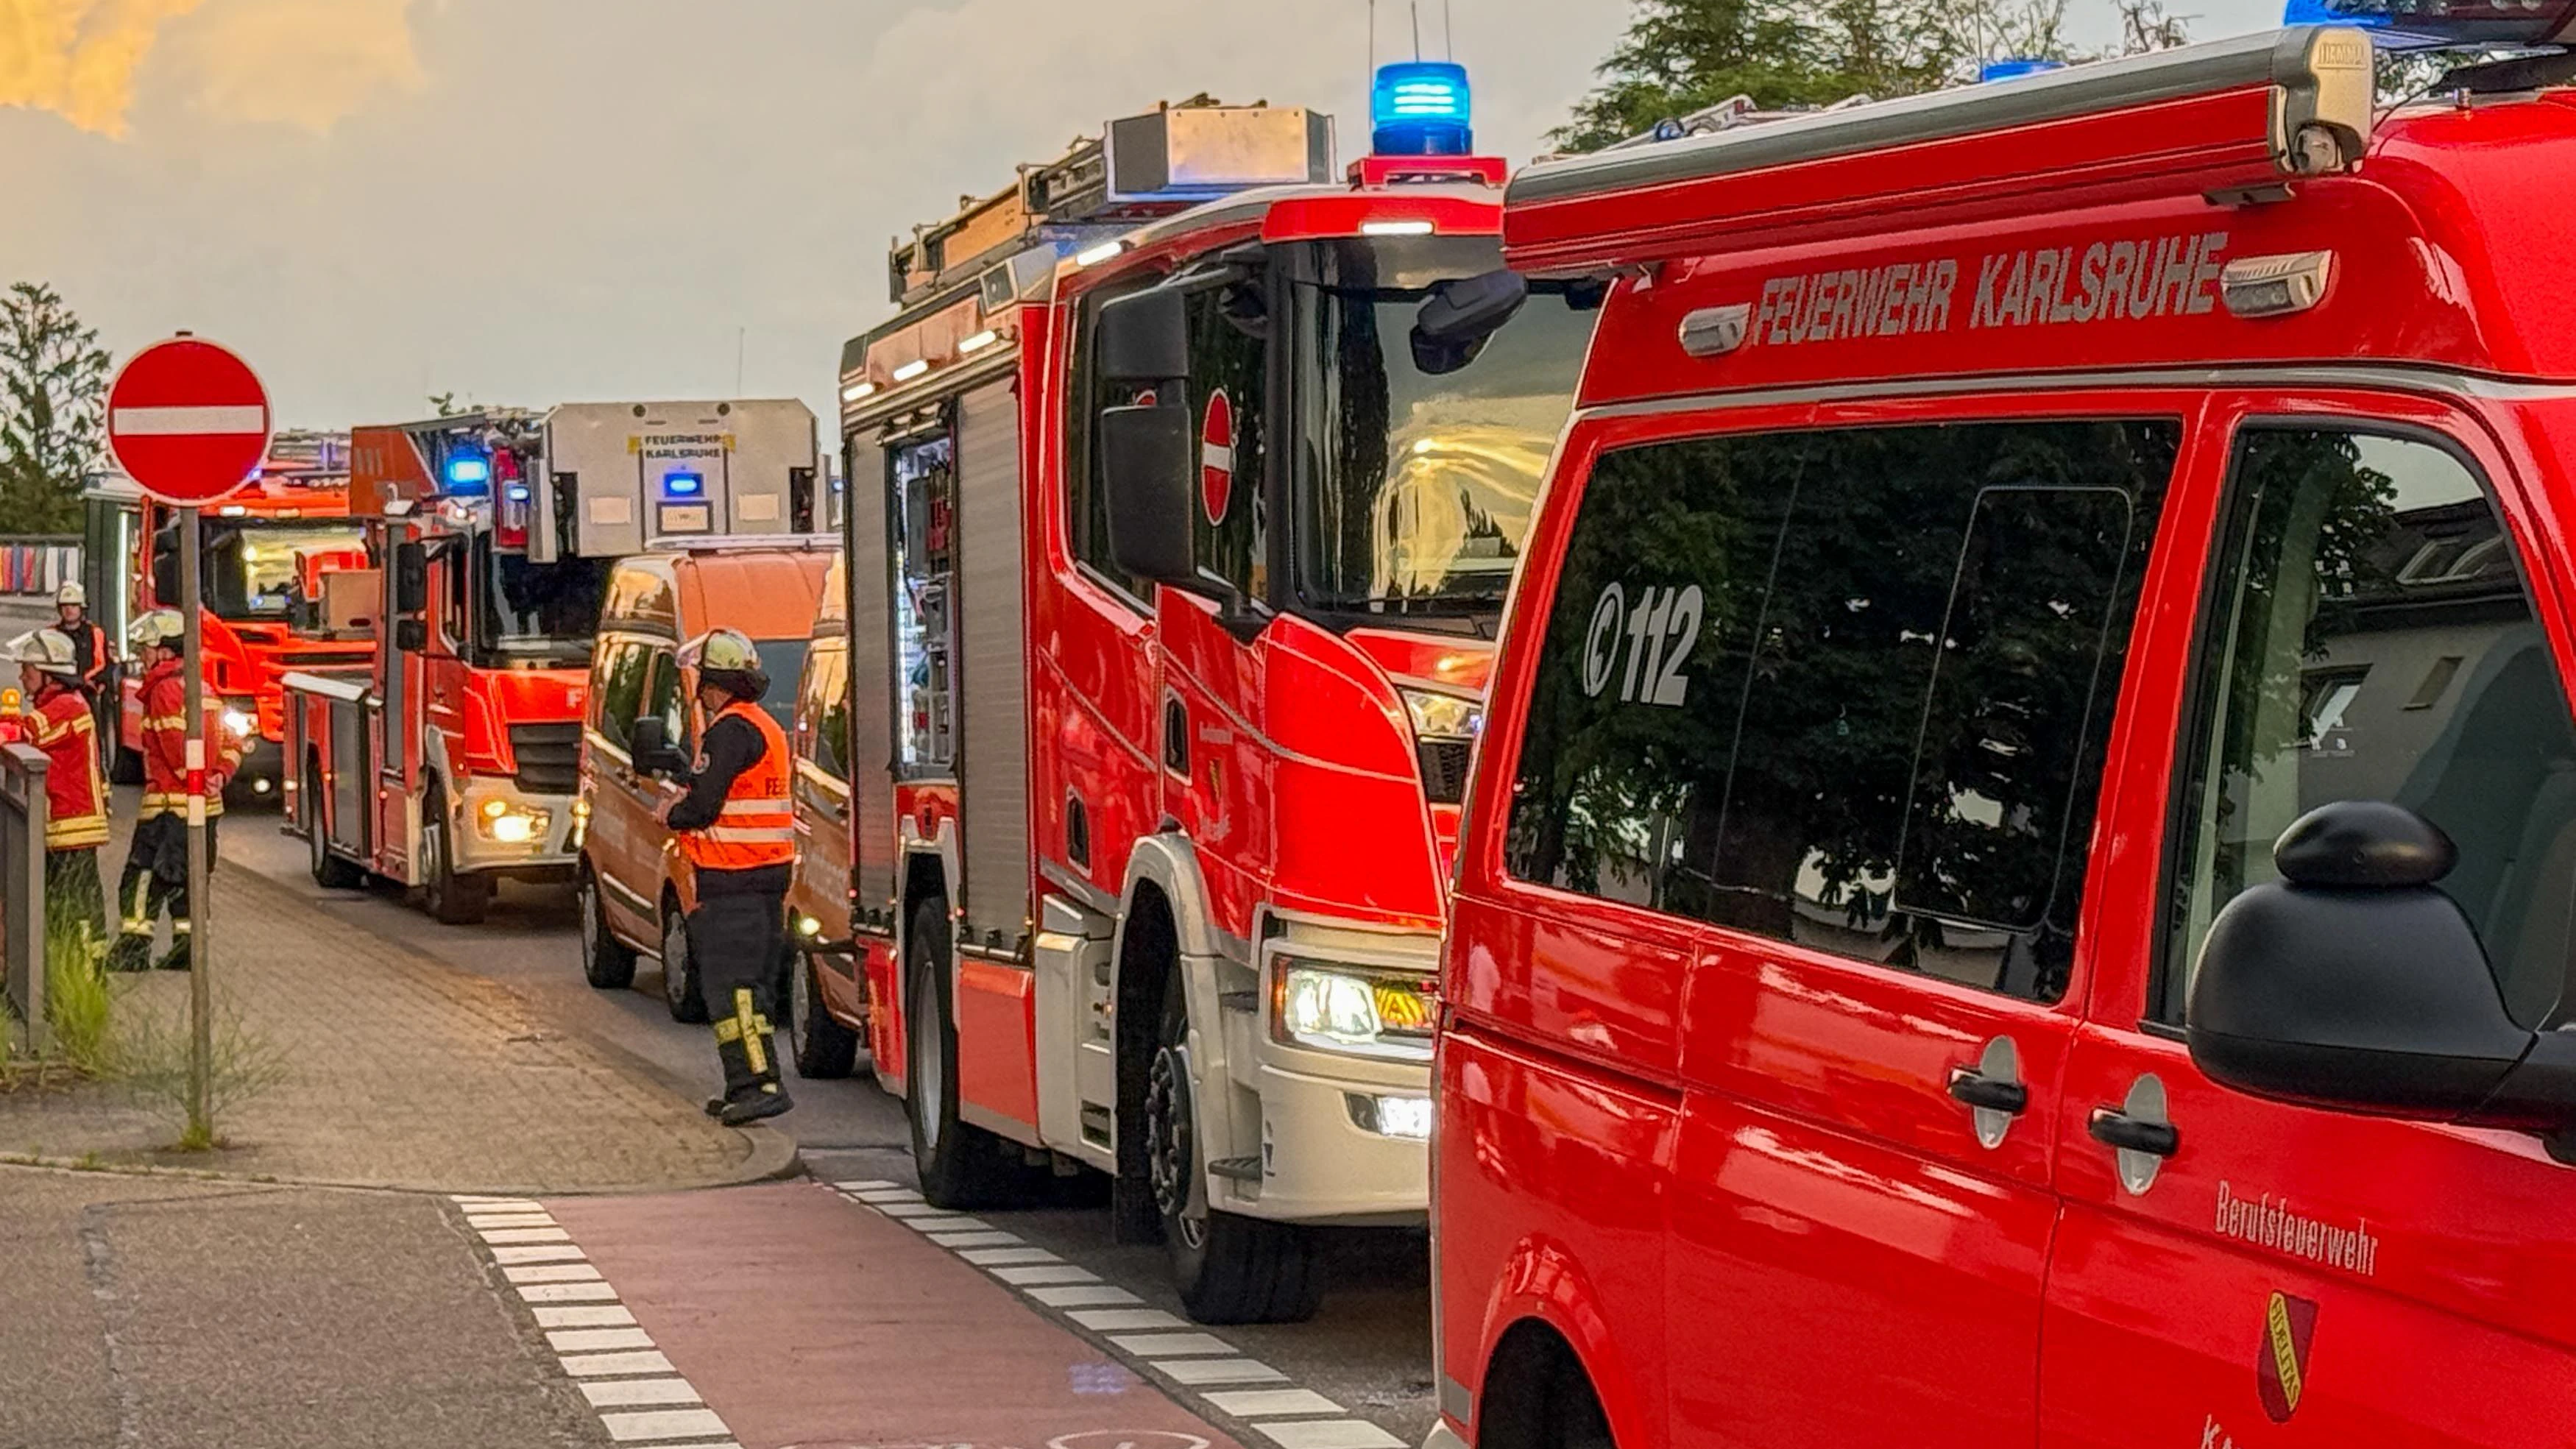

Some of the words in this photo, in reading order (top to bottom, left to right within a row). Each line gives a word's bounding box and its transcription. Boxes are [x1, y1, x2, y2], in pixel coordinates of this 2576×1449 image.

[1754, 259, 1958, 346] FEUERWEHR
[1970, 232, 2229, 330] KARLSRUHE
[1620, 584, 1704, 706] 112
[2215, 1180, 2378, 1277] Berufsfeuerwehr
[2271, 1297, 2299, 1404] FIDELITAS
